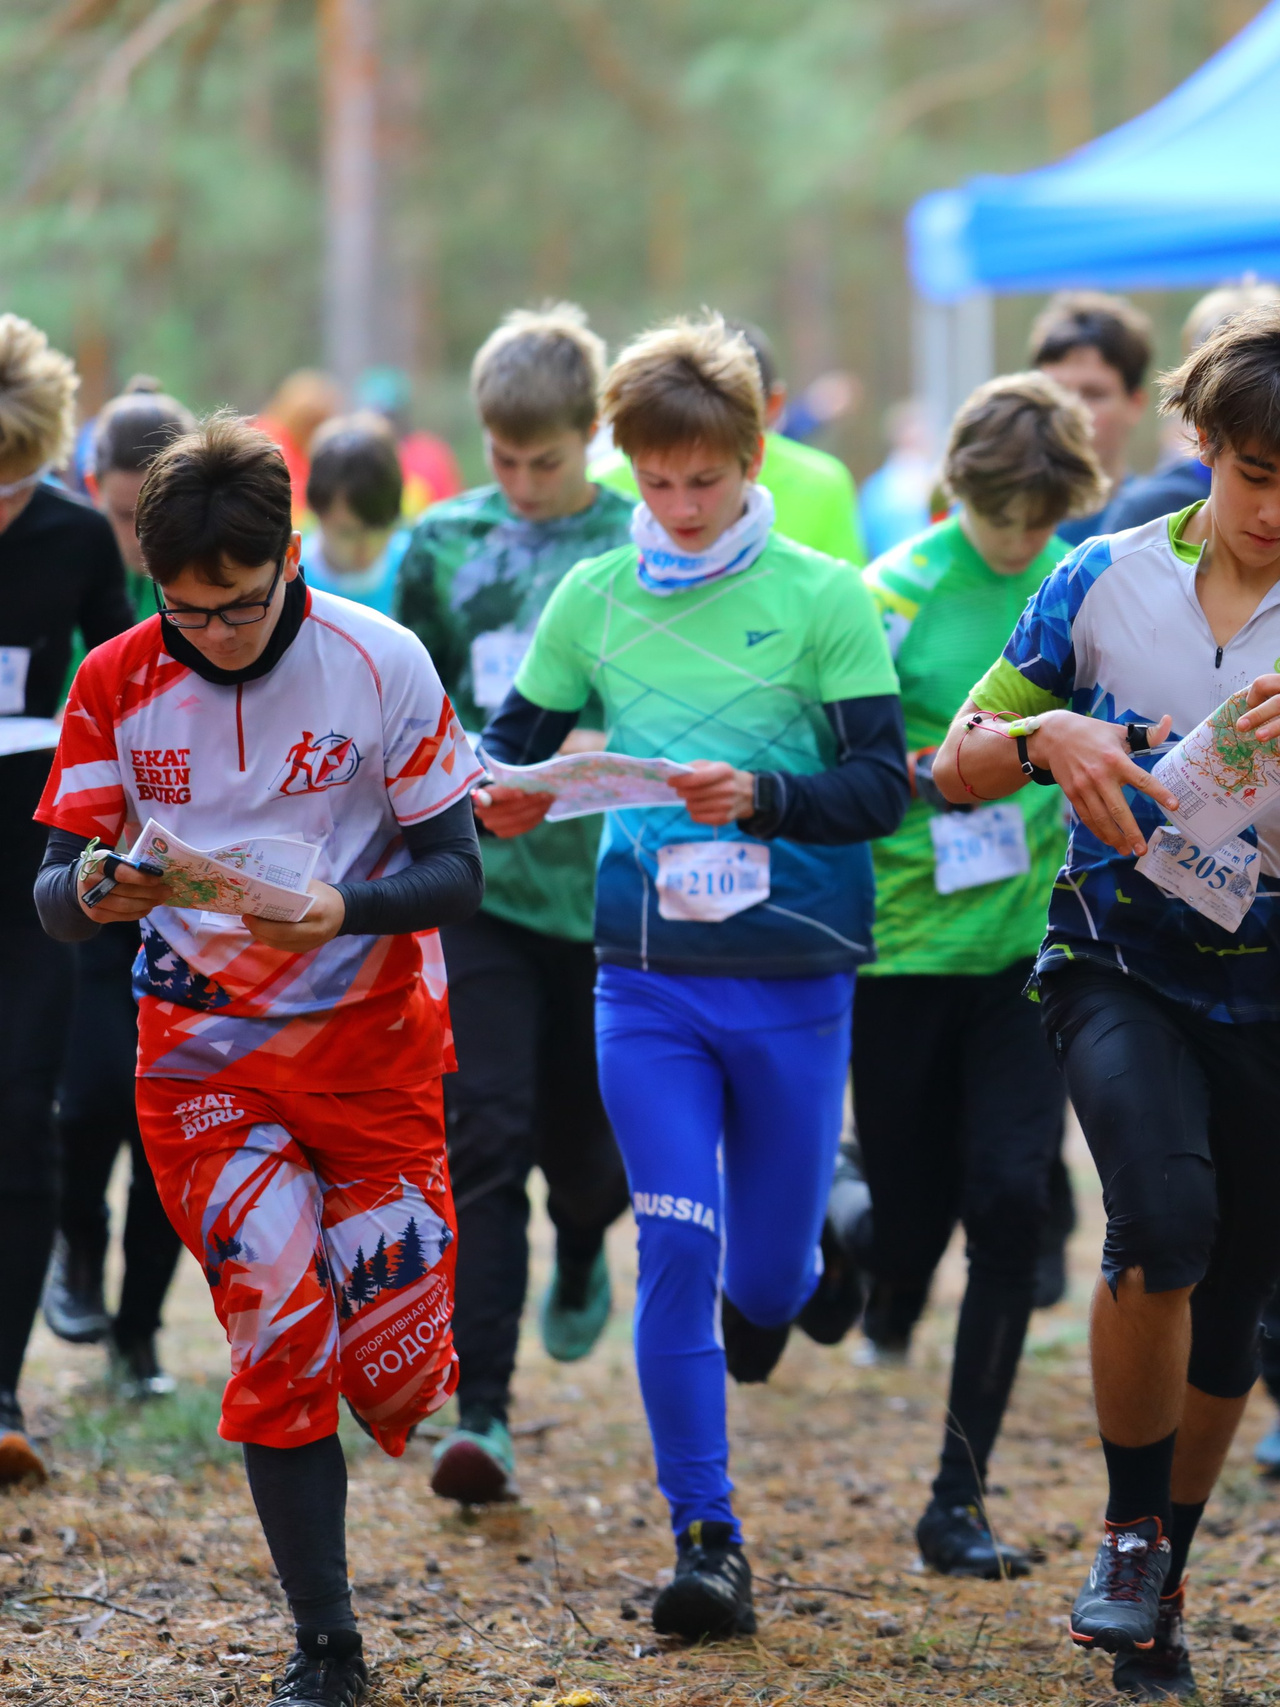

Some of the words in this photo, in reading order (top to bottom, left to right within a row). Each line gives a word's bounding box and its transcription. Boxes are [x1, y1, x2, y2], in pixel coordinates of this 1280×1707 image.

[131, 749, 190, 767] EKAT
[133, 767, 191, 785] ERIN
[136, 784, 191, 805] BURG
[688, 869, 734, 895] 210
[1177, 845, 1234, 890] 205
[181, 1108, 245, 1140] BURG
[633, 1191, 716, 1233] RUSSIA
[355, 1302, 427, 1361] СПОРТИВНАЯ
